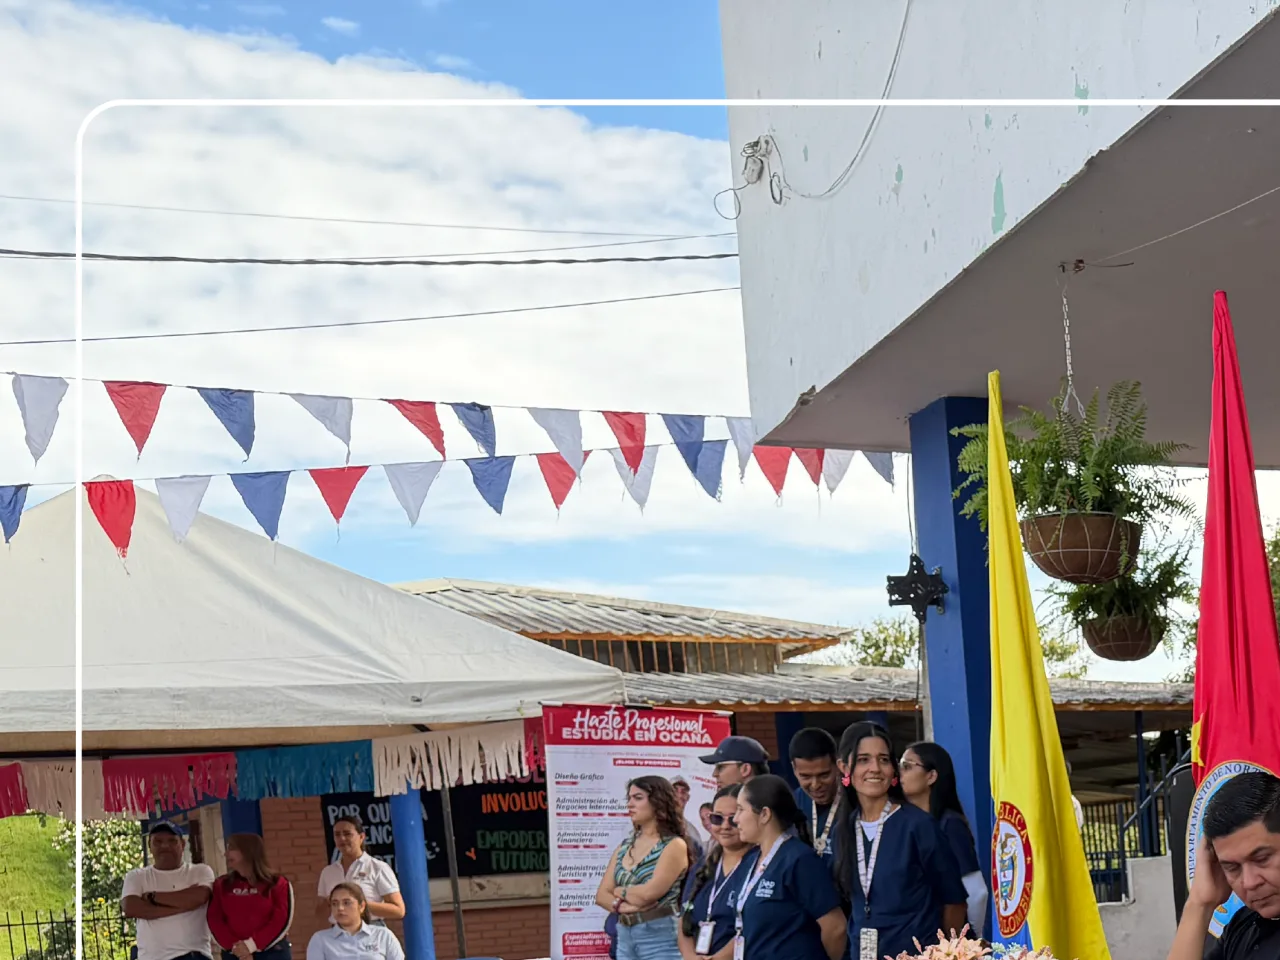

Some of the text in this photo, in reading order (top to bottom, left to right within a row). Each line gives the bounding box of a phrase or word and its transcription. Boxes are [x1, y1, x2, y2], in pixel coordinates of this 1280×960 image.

[573, 704, 707, 736] Hazte Profesional
[562, 727, 631, 741] ESTUDIA
[635, 730, 656, 742] EN
[555, 772, 605, 781] Diseño Gráfico
[1210, 767, 1225, 782] DE
